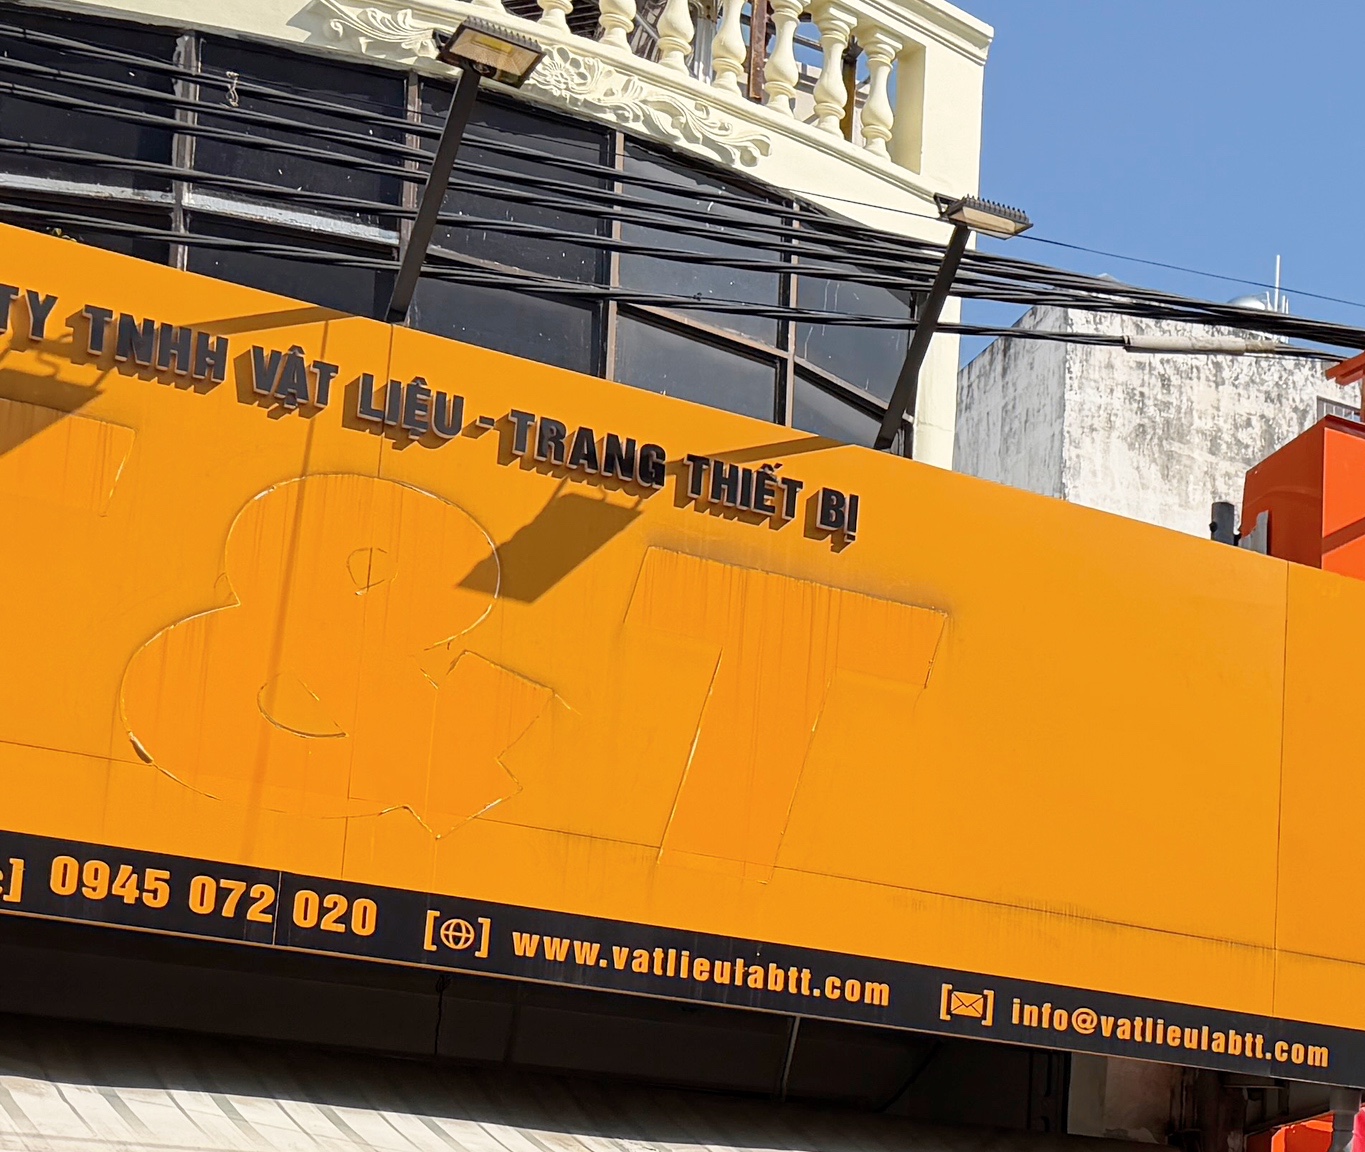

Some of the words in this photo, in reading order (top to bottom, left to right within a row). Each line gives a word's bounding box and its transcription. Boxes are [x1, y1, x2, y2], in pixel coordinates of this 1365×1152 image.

[82, 304, 229, 383] TNHH
[252, 344, 340, 412] VẬT
[358, 372, 464, 440] LIỆU
[508, 409, 666, 488] TRANG
[683, 454, 802, 521] THIẾT
[819, 486, 860, 543] BỊ
[48, 855, 170, 908] 0945
[188, 875, 275, 924] 072
[292, 889, 379, 937] 020
[512, 928, 890, 1007] www.vatlieulabtt.com
[1011, 996, 1329, 1069] info@vatlieulabtt.com
